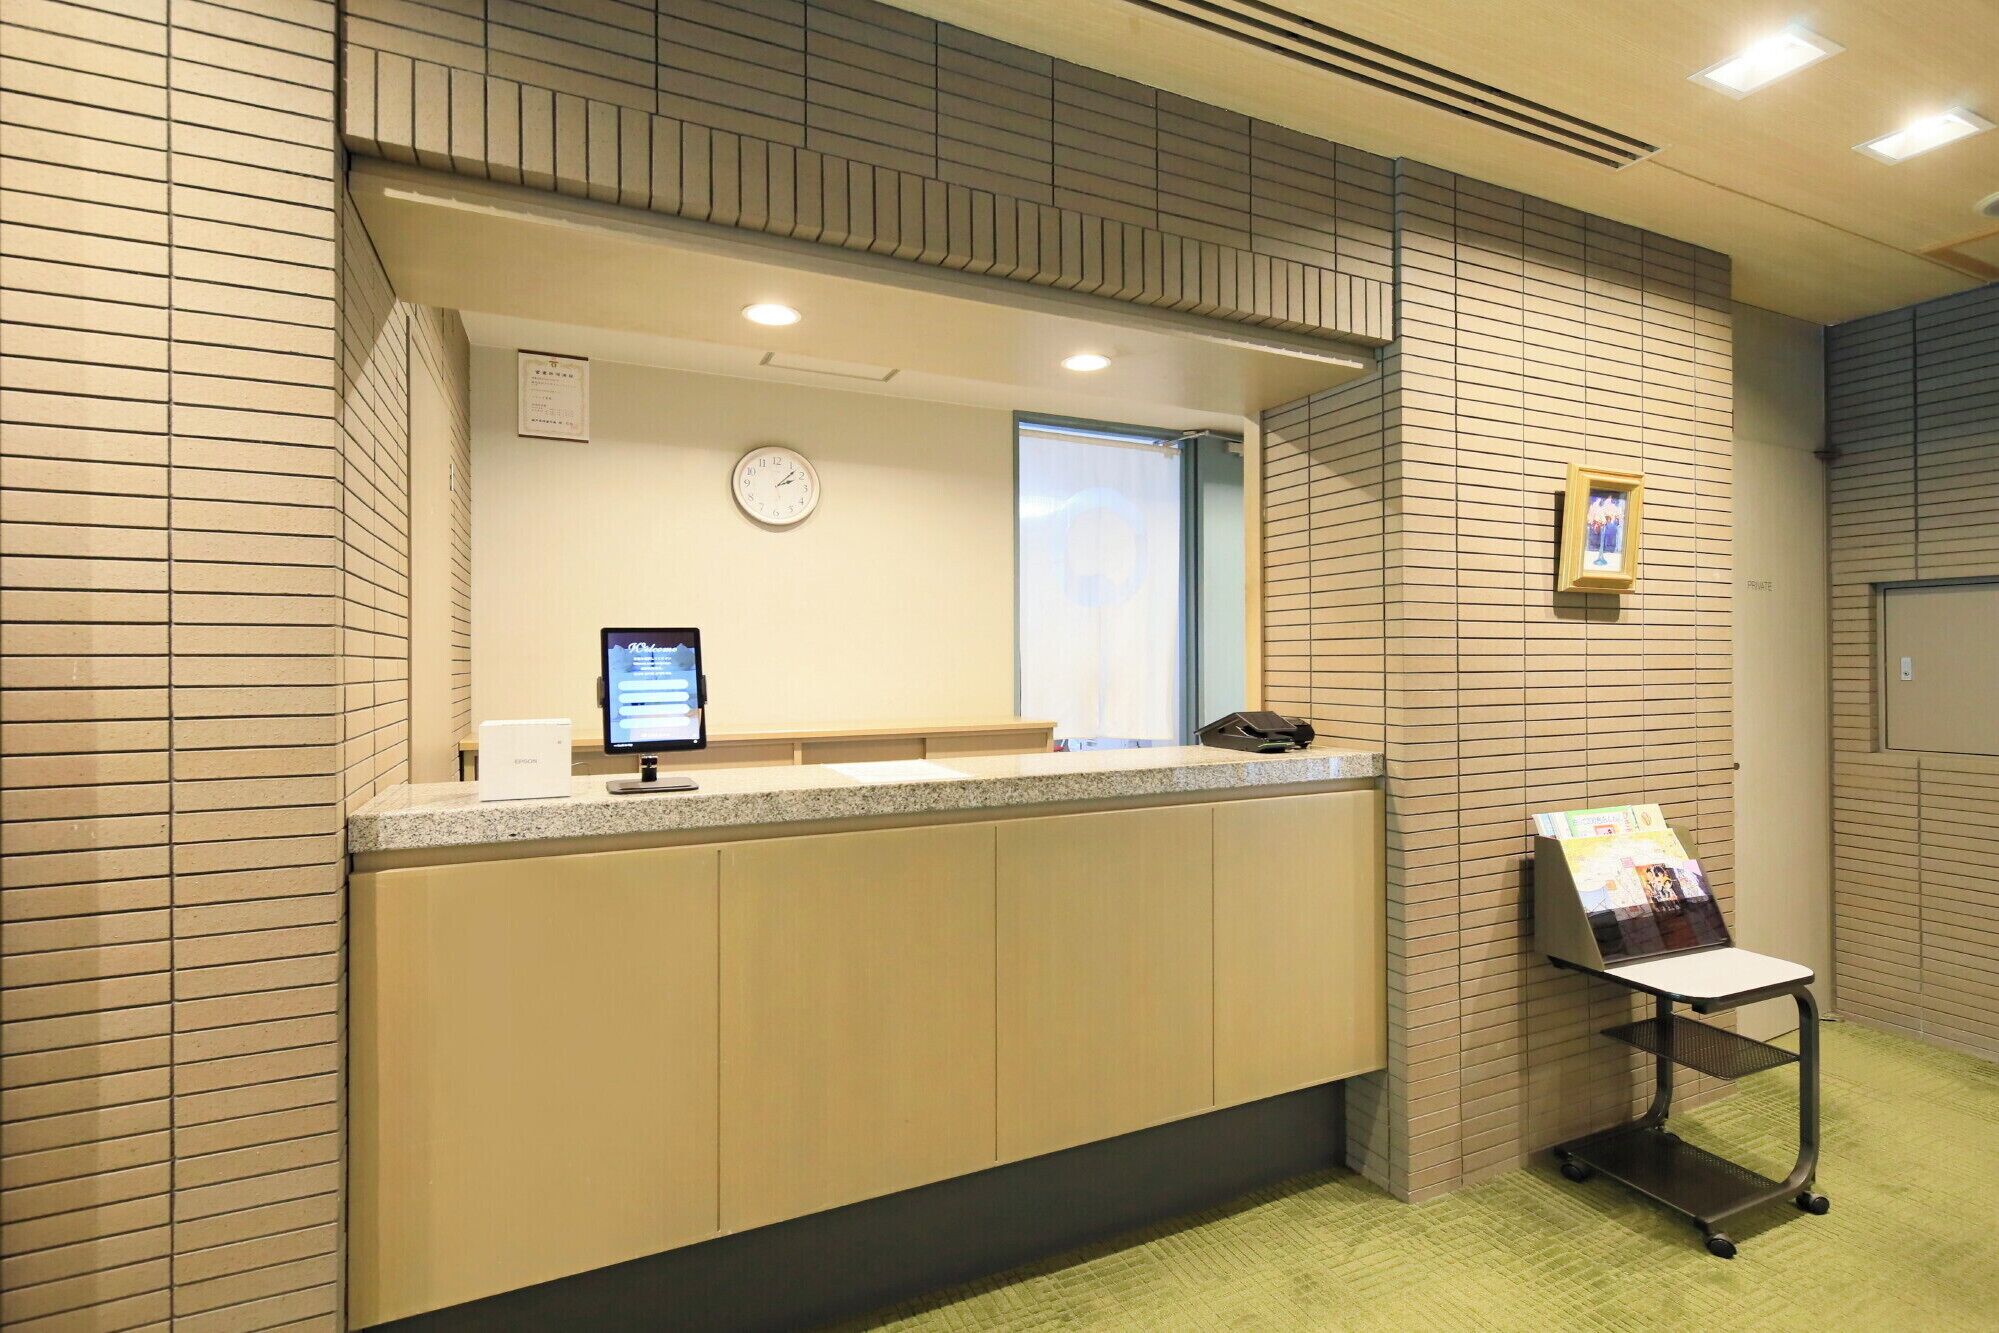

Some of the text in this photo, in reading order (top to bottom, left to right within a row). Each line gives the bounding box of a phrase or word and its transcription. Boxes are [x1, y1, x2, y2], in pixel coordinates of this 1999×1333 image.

[759, 459, 766, 468] 11
[773, 457, 782, 466] 12
[746, 467, 756, 475] 10
[627, 642, 678, 654] Welcome
